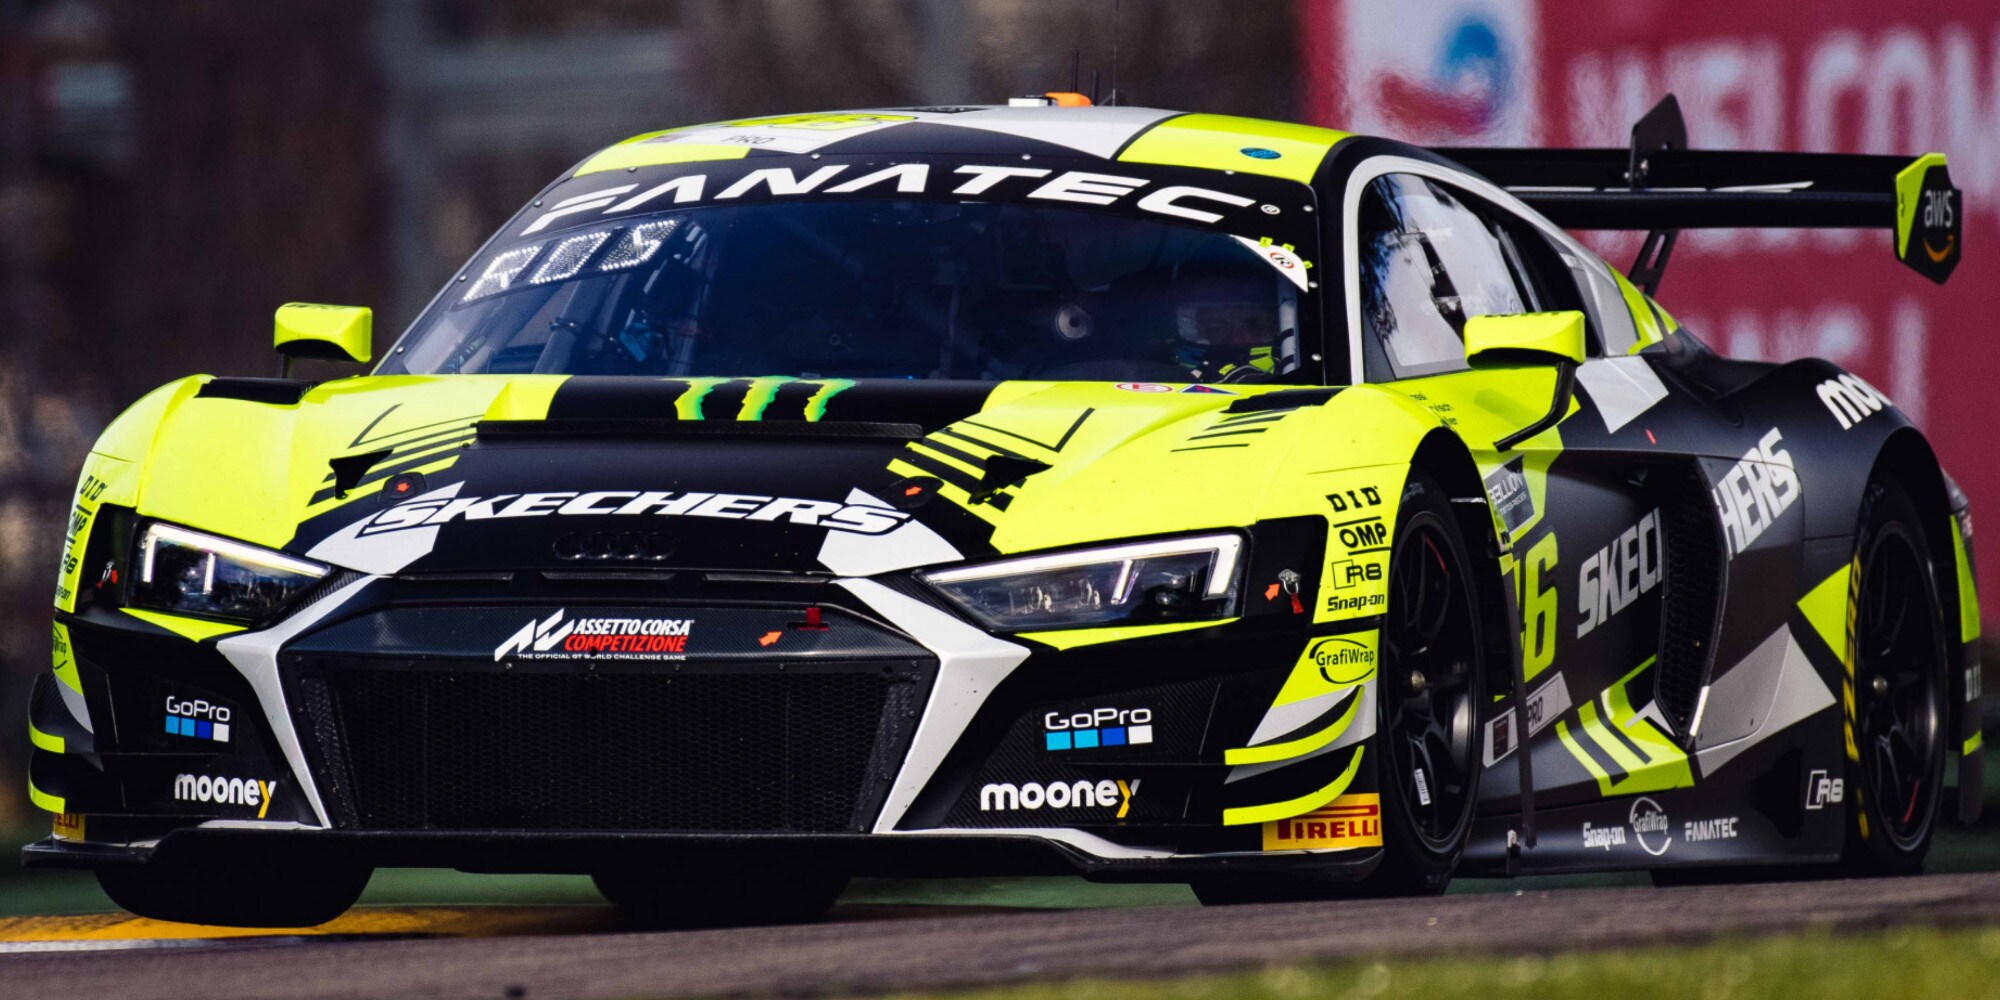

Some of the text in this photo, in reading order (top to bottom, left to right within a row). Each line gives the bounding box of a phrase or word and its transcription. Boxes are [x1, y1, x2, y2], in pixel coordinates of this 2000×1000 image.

[520, 163, 1256, 236] FANATEC
[1924, 189, 1954, 229] aws
[361, 490, 910, 534] SKECHERS
[1339, 522, 1387, 549] OMP
[1345, 562, 1382, 584] R8
[1327, 593, 1385, 613] Snap-on
[1512, 530, 1559, 684] 6
[573, 618, 692, 636] ASSETTO CORSA
[564, 635, 688, 653] COMPETIZIONE
[613, 653, 661, 661] CHALLENGE
[1316, 647, 1375, 667] GrafiWrap
[166, 696, 230, 722] GoPro
[1045, 707, 1152, 730] GoPro
[174, 773, 276, 819] mooney
[980, 779, 1142, 818] mooney
[1816, 776, 1843, 804] R8
[1278, 804, 1379, 841] PIRELLI
[1632, 812, 1668, 835] GrafiWrap
[1684, 817, 1739, 842] FANATEC
[1583, 822, 1626, 851] Snap-on
